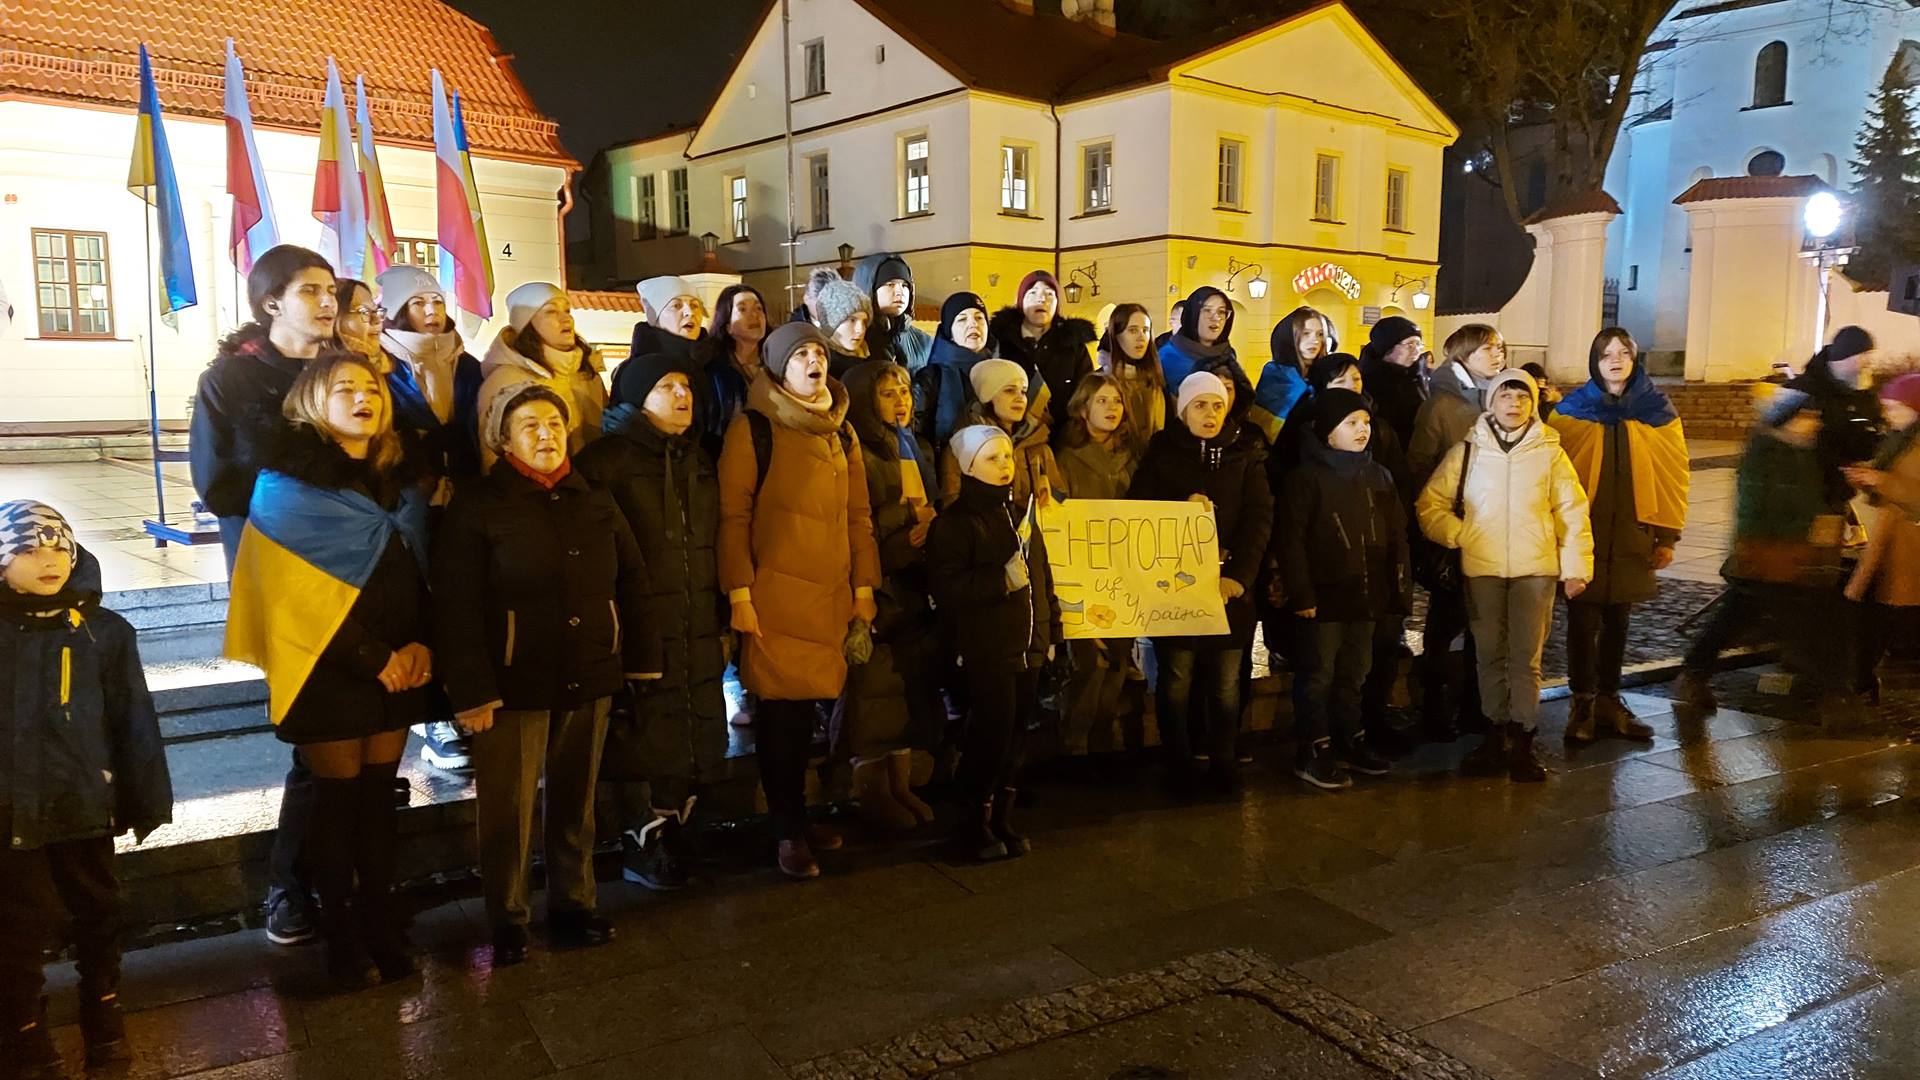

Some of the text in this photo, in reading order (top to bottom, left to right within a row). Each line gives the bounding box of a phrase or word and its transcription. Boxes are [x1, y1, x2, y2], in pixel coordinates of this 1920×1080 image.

[502, 242, 512, 257] 4
[1094, 576, 1124, 601] це
[1121, 593, 1214, 632] Україна
